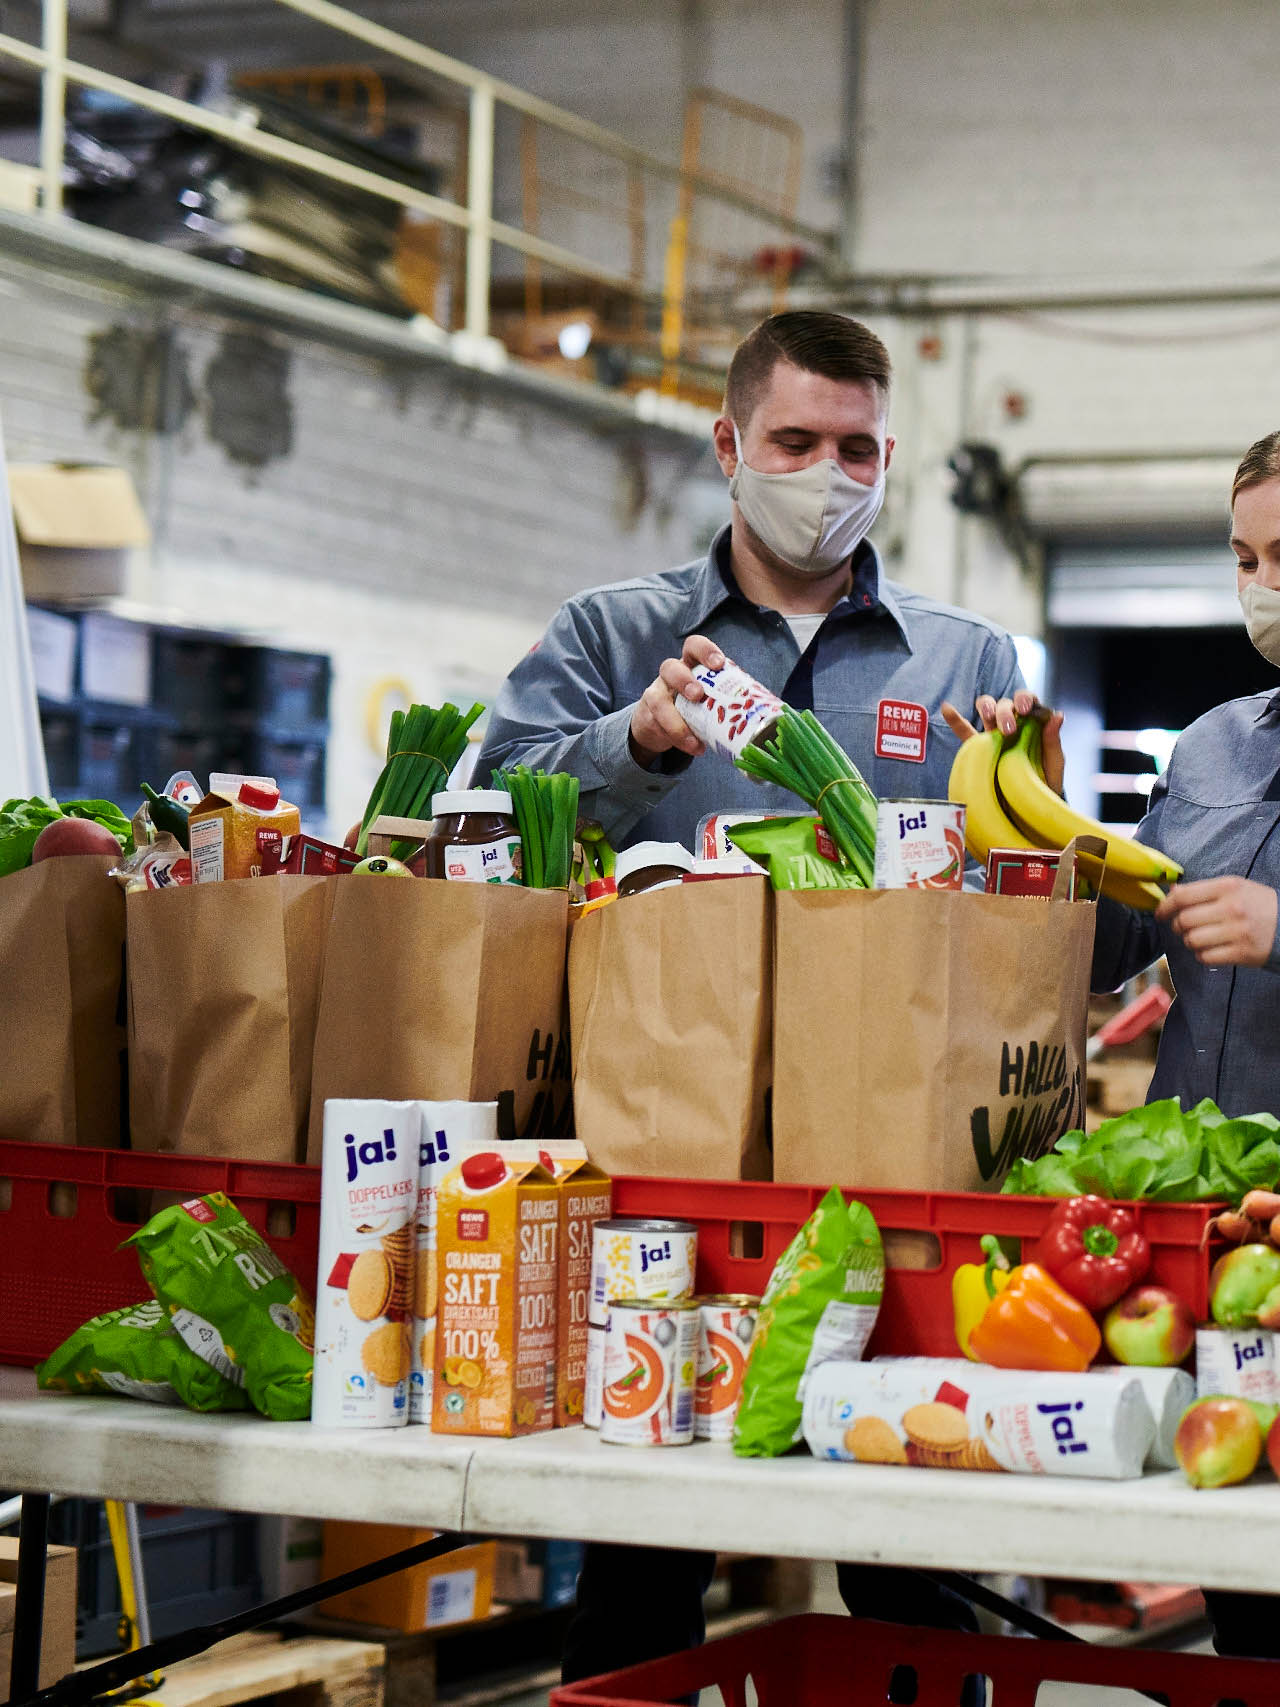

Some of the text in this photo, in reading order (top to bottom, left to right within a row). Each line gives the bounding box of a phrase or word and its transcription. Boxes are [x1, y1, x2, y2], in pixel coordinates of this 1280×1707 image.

[882, 718, 898, 731] DEIN
[883, 705, 921, 722] REWE
[259, 832, 278, 840] REWE
[898, 811, 927, 839] ja!
[481, 849, 498, 866] ja!
[344, 1128, 397, 1183] ja!
[419, 1130, 450, 1167] a!
[521, 1200, 558, 1220] ORANGEN
[568, 1197, 611, 1217] ORANGEN
[520, 1223, 557, 1264] SAFT
[639, 1240, 671, 1272] ja!
[446, 1253, 501, 1270] ORANGEN
[445, 1273, 501, 1305] SAFT
[519, 1293, 556, 1329] 100%
[568, 1289, 587, 1323] 10
[443, 1329, 499, 1360] 100%
[1233, 1337, 1264, 1370] ja!
[1036, 1401, 1088, 1455] ja!
